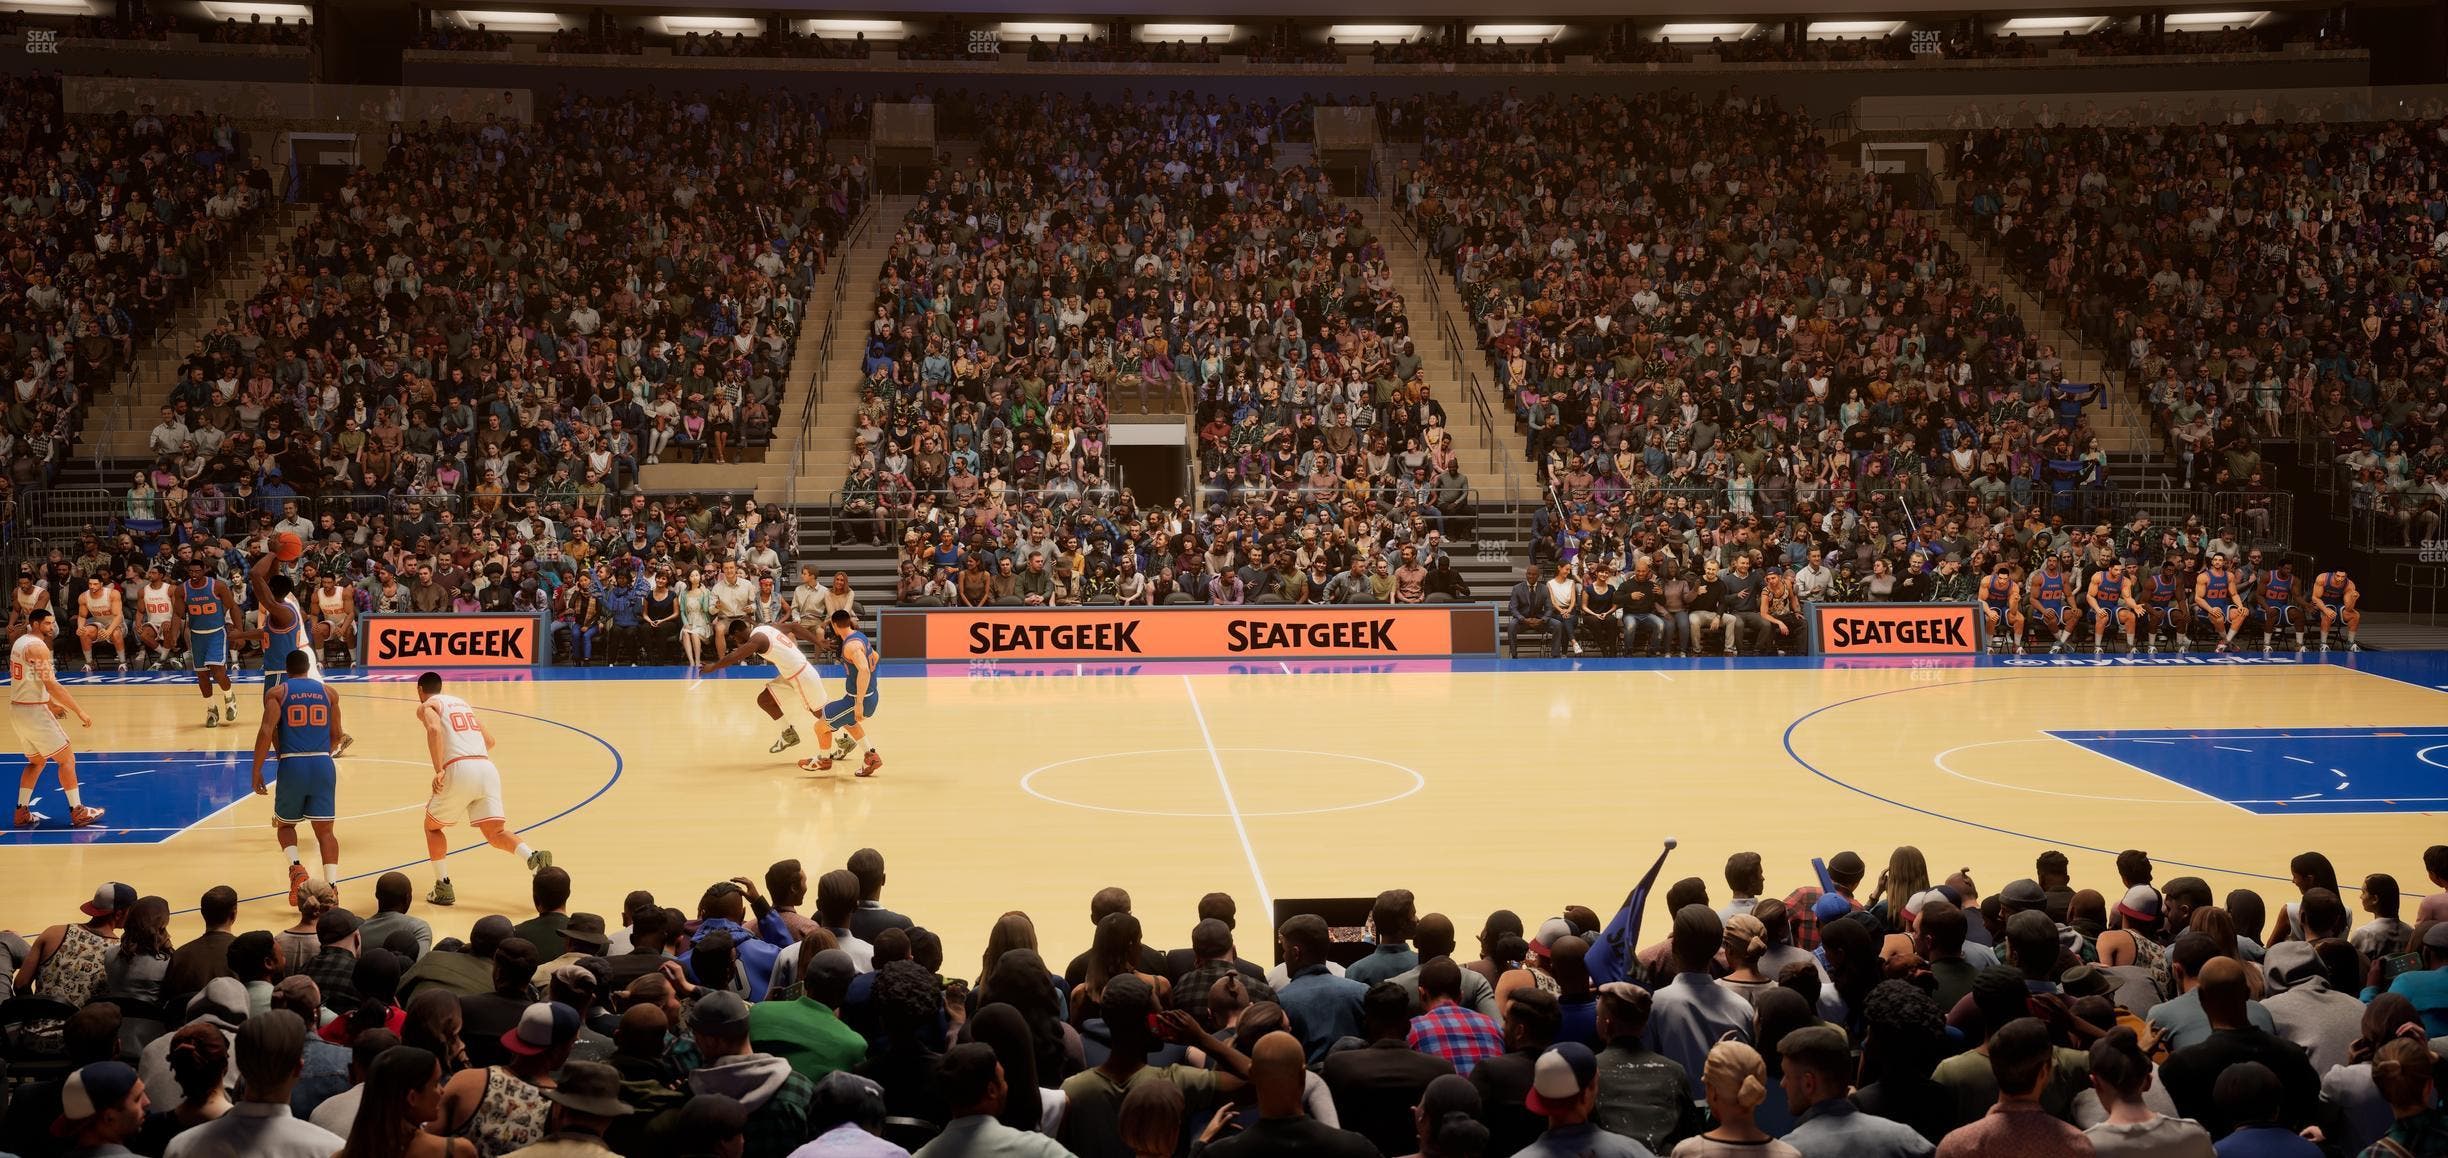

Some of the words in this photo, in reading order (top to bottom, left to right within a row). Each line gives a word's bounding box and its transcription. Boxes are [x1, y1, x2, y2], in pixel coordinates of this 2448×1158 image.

[188, 602, 218, 616] 00
[379, 627, 524, 660] SEATGEEK
[970, 620, 1142, 654] SEATGEEK
[1227, 618, 1398, 652] SEATGEEK
[1833, 617, 1968, 648] SEATGEEK
[2003, 656, 2297, 666] @nyknicks
[290, 692, 323, 700] PLAYER
[287, 704, 328, 727] 00
